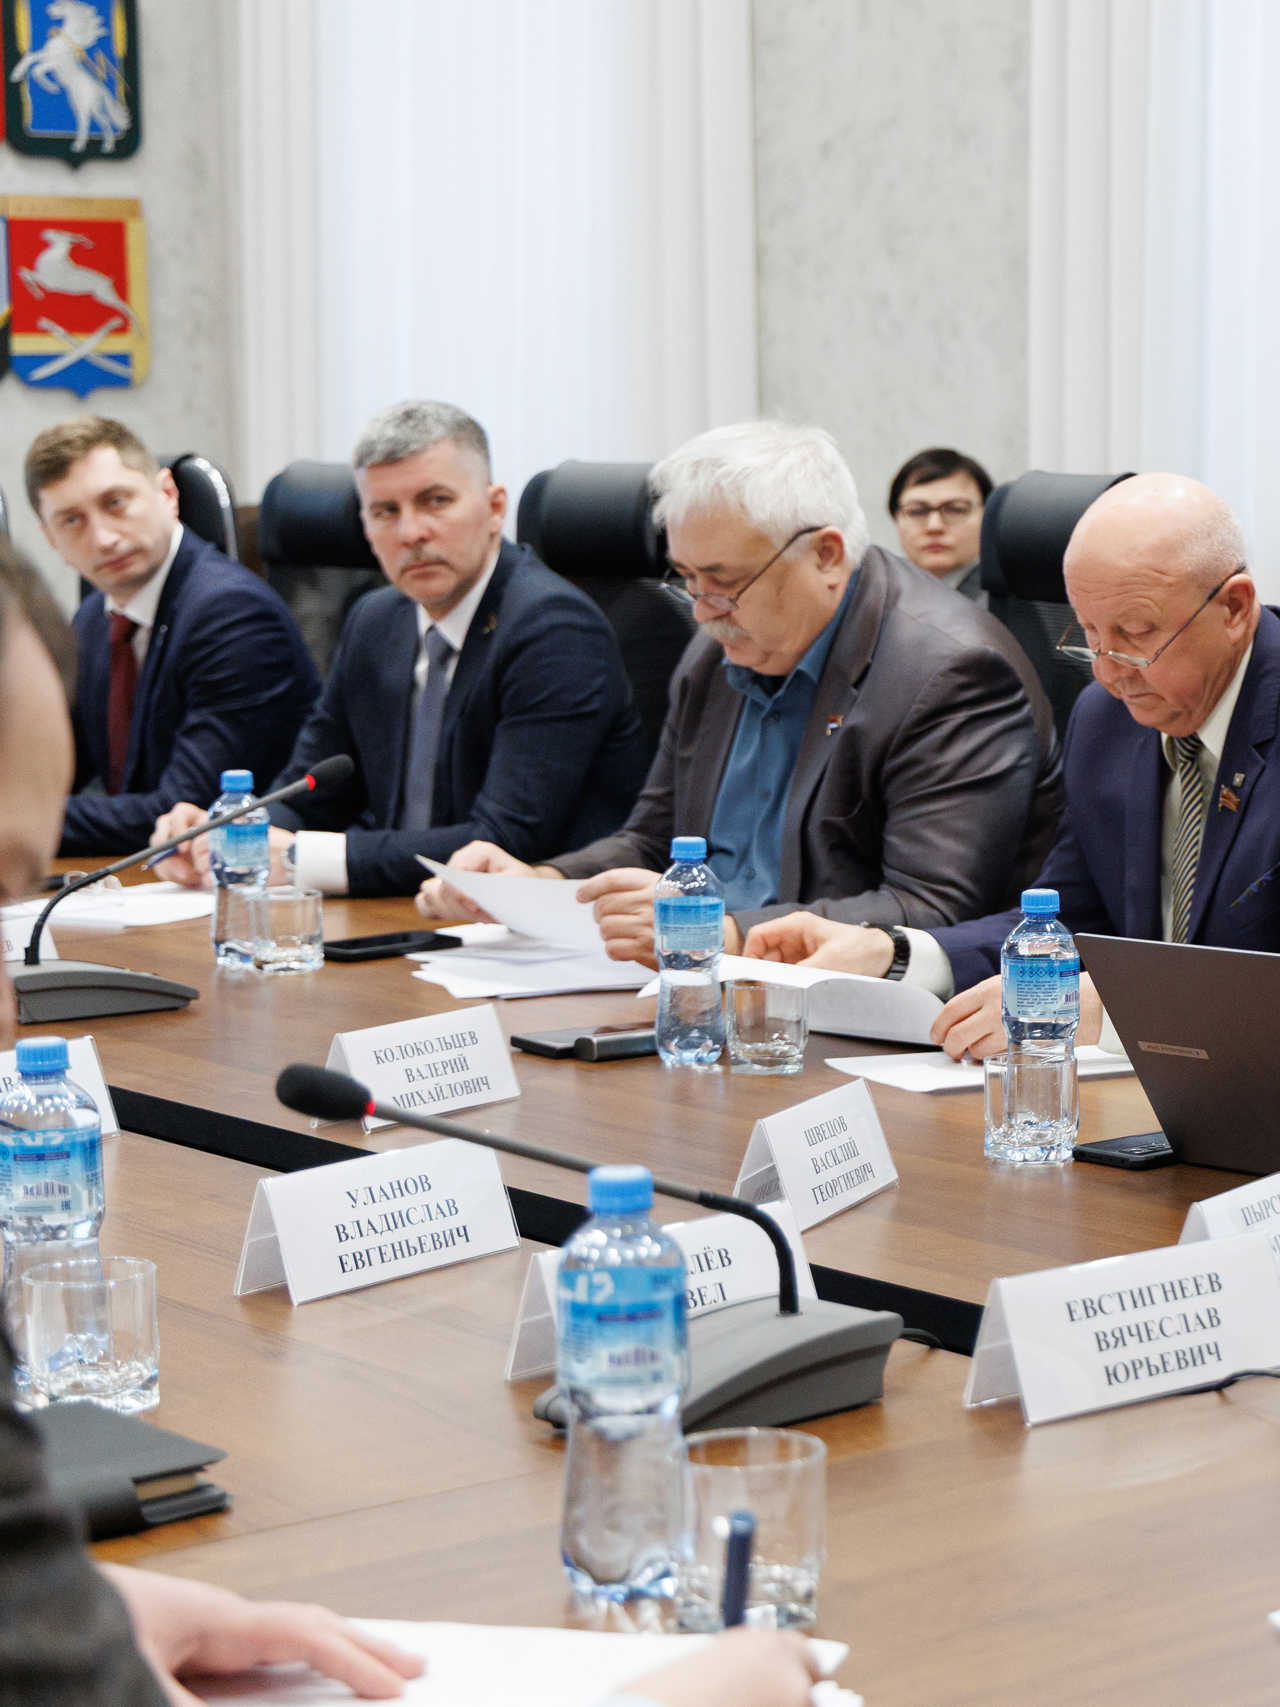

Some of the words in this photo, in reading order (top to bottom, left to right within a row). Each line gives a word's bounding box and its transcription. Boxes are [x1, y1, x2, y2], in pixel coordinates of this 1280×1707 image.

[373, 1030, 479, 1065] КОЛОКОЛЬЦЕВ
[404, 1053, 470, 1083] ВАЛЕРИЙ
[392, 1075, 491, 1109] МИХАЙЛОВИЧ
[803, 1115, 848, 1147] ШВЕЦОВ
[810, 1136, 860, 1175] ВАСИЛИЙ
[345, 1174, 432, 1209] УЛАНОВ
[811, 1161, 876, 1206] ГЕОРГИЕВИЧ
[334, 1198, 459, 1244] ВЛАДИСЛАВ
[337, 1224, 471, 1275] ЕВГЕНЬЕВИЧ
[688, 1246, 732, 1276] ЛЁВ
[687, 1281, 728, 1310] ВЕЛ
[1065, 1272, 1223, 1322] ЕВСТИГНЕЕВ
[1094, 1307, 1222, 1353] ВЯЧЕСЛАВ
[1103, 1341, 1223, 1386] ЮРЬЕВИЧ
